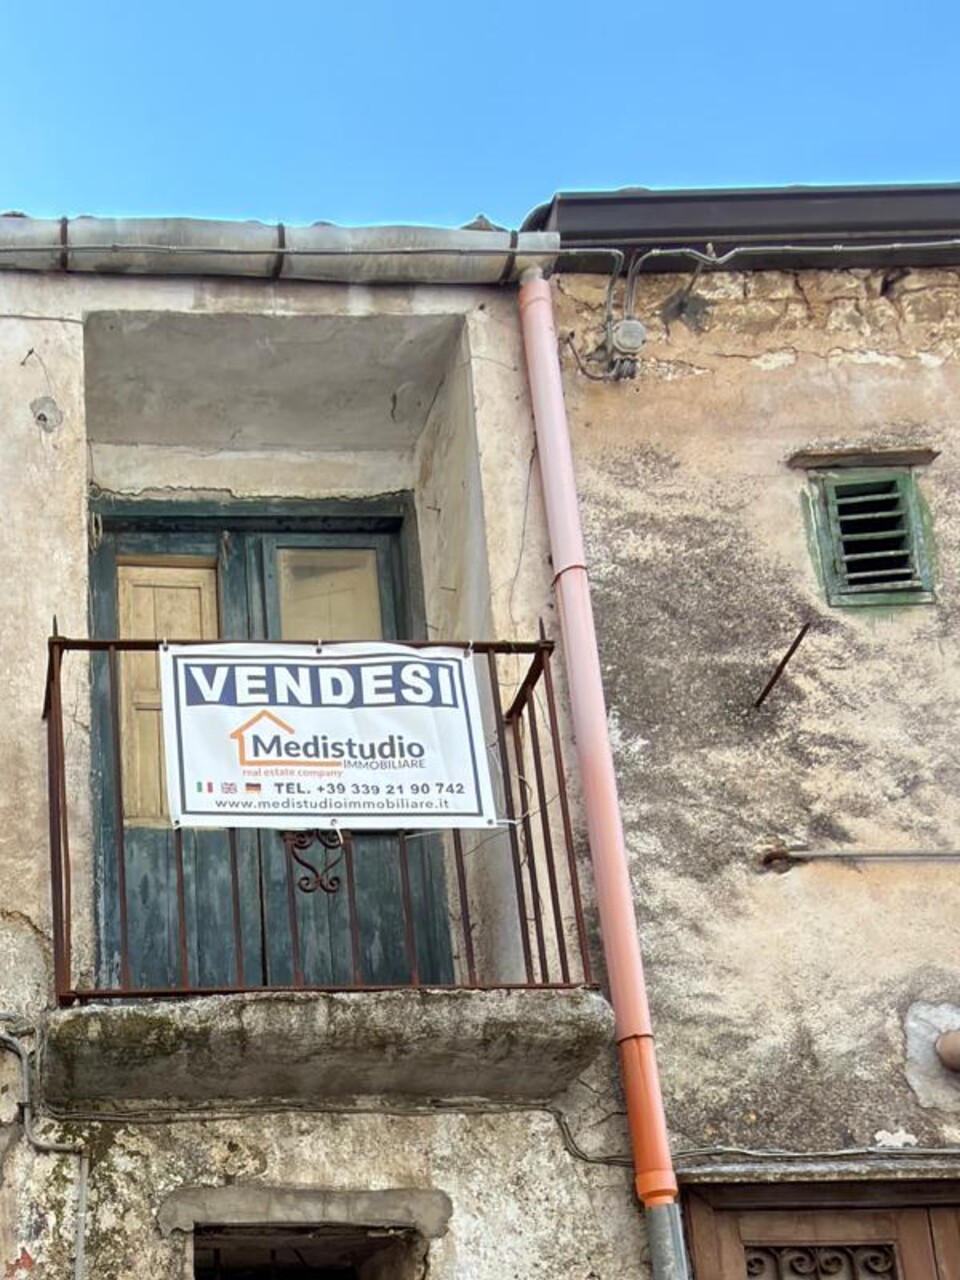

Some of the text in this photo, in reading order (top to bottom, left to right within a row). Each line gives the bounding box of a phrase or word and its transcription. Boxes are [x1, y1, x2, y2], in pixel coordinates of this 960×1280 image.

[190, 663, 453, 706] VENDESI
[252, 734, 425, 759] Medistudio
[343, 759, 426, 770] IMMOBILIARE
[243, 768, 343, 779] real estate company
[274, 782, 465, 795] TEL. +39 339 21 90 742
[215, 798, 449, 810] www.medistudioimmobiliare.it
